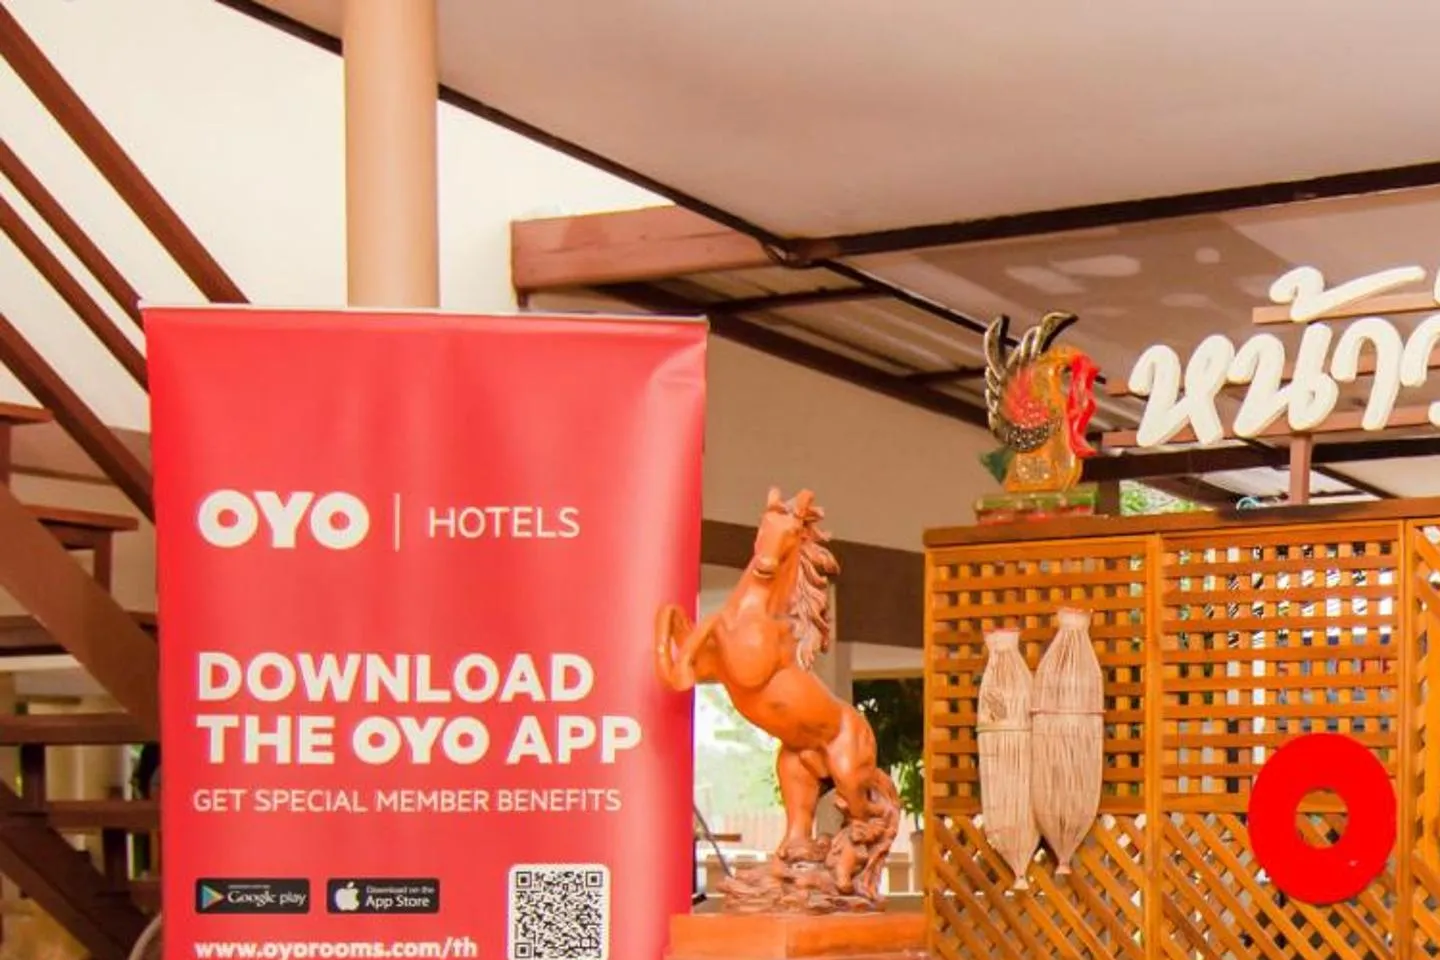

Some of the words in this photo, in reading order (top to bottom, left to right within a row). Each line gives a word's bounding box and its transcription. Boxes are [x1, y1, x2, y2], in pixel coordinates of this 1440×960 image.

[197, 488, 370, 550] OYO
[427, 506, 581, 539] HOTELS
[196, 652, 595, 703] DOWNLOAD
[196, 715, 336, 765] THE
[352, 716, 490, 765] OYO
[505, 716, 642, 765] APP
[193, 788, 248, 812] GET
[254, 788, 368, 813] SPECIAL
[375, 789, 489, 813] MEMBER
[497, 788, 623, 812] BENEFITS
[227, 890, 276, 907] Google
[279, 891, 307, 907] play
[365, 895, 394, 910] App
[396, 894, 431, 908] Store
